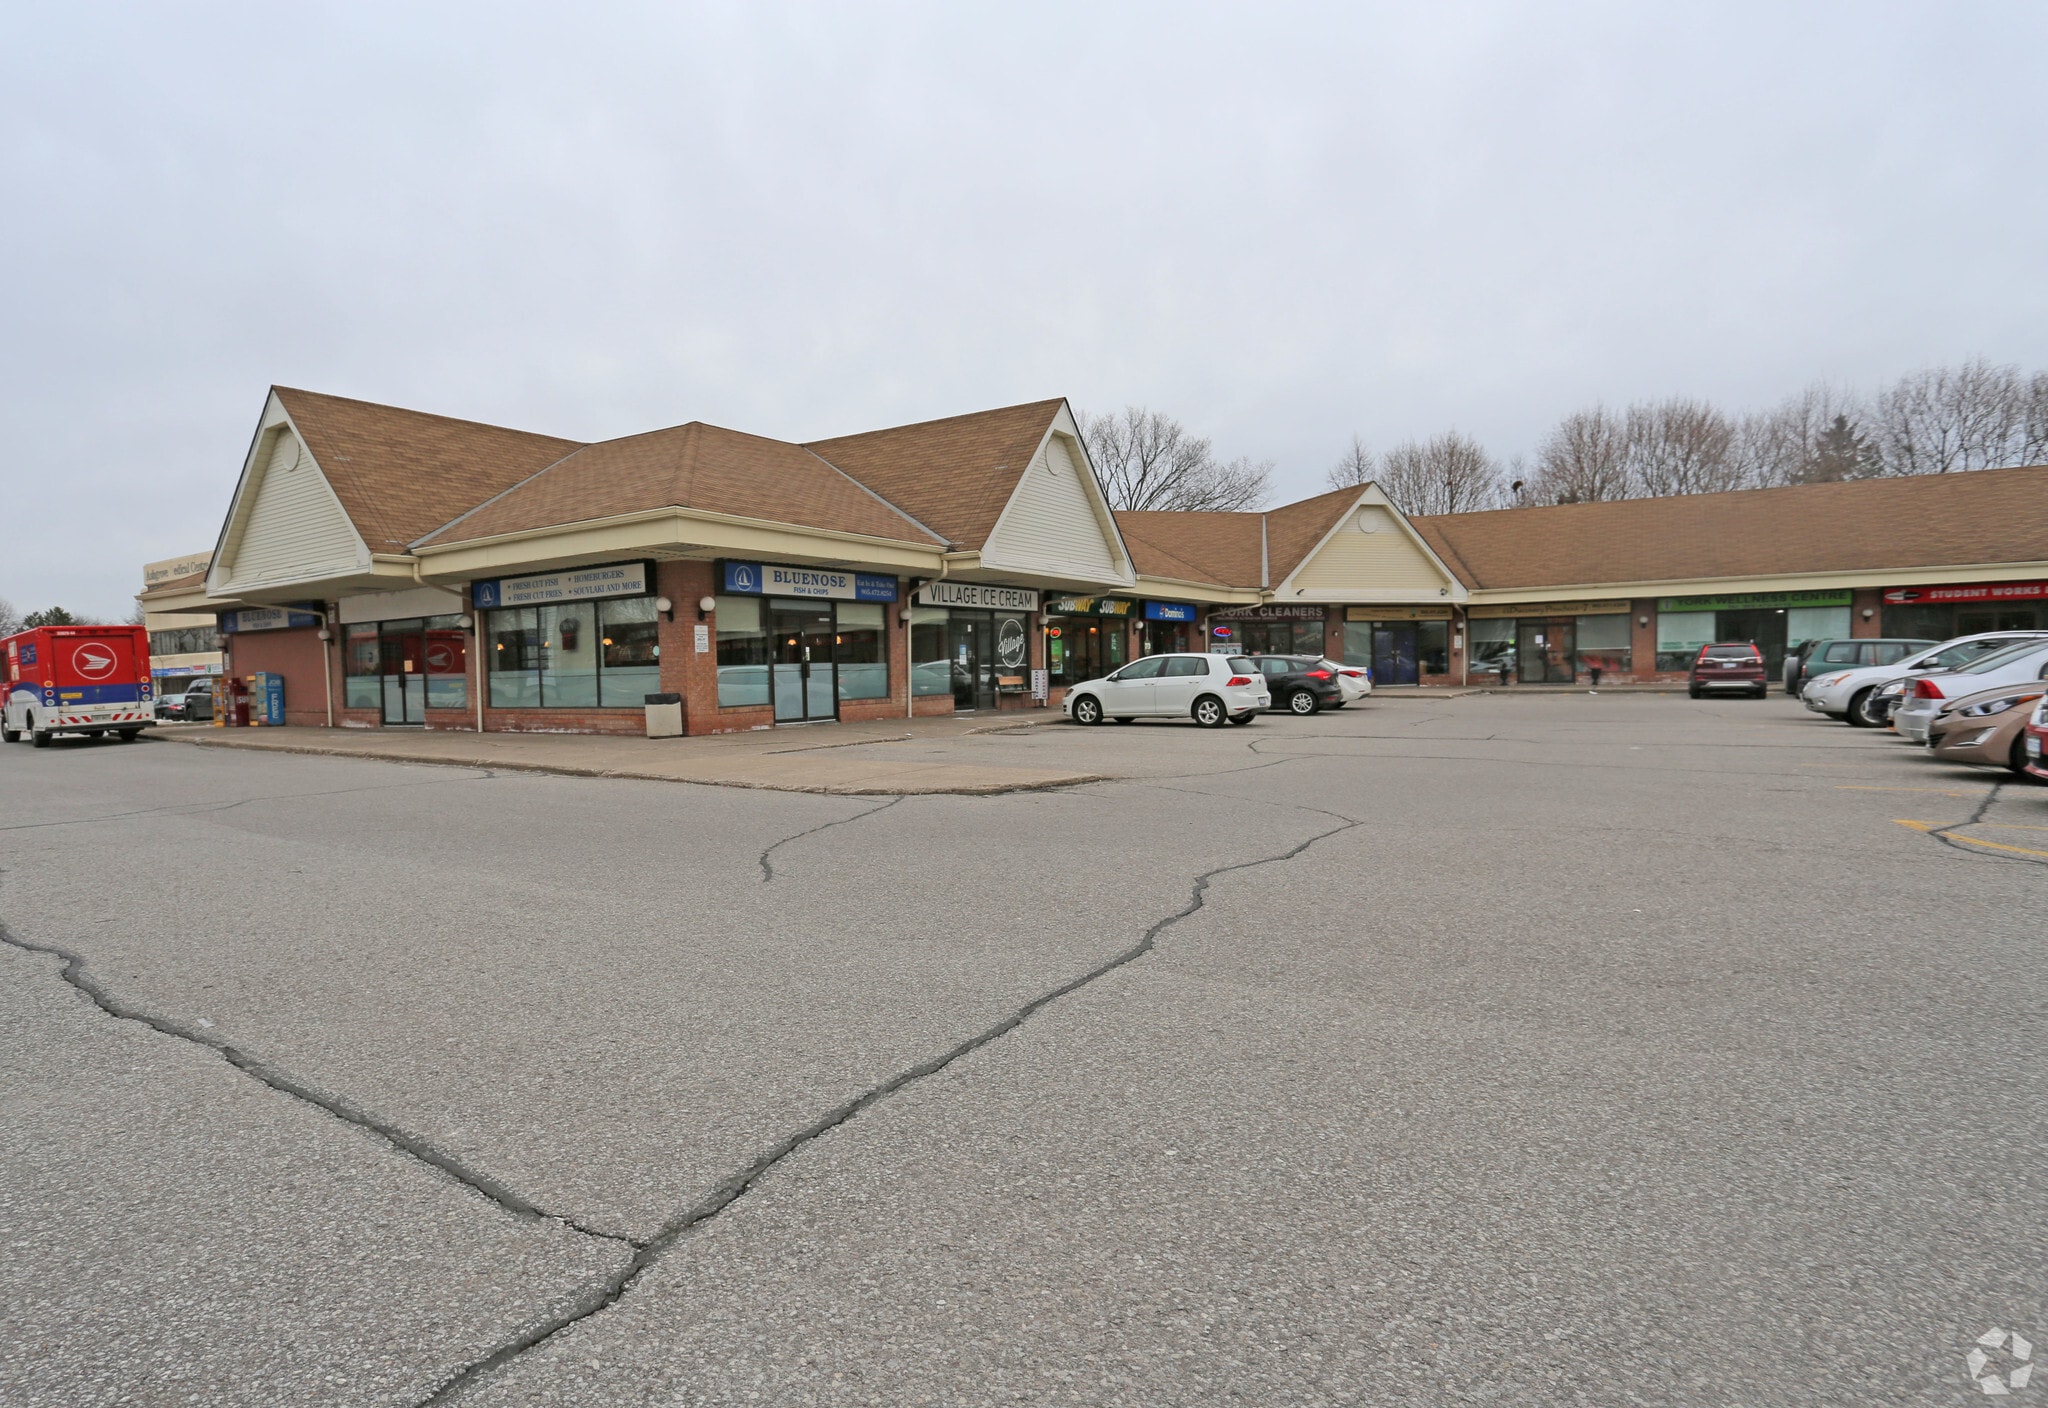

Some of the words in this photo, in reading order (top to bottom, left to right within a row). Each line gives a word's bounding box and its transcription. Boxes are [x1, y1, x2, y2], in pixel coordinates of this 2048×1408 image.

[574, 570, 625, 583] HOMEBURGERS
[773, 570, 847, 588] BLUENOSE
[513, 581, 531, 591] FRESH
[532, 580, 544, 588] CUT
[545, 578, 559, 587] FISH
[574, 584, 605, 595] SOUVLAKI
[606, 582, 620, 592] AND
[622, 580, 642, 590] MORE
[793, 586, 807, 594] FISH
[813, 588, 830, 596] CHIPS
[514, 592, 532, 601] FRESH
[533, 591, 545, 600] CUT
[546, 589, 563, 598] FRIES
[930, 584, 977, 604] VILLAGE
[980, 587, 996, 606] ICE
[999, 590, 1032, 608] CREAM
[1678, 598, 1712, 607] YORK
[1716, 593, 1788, 605] WELLNESS
[1791, 590, 1848, 602] CENTRE
[1930, 588, 1988, 599] STUDENT
[1991, 586, 2041, 596] WORKS
[1058, 597, 1092, 613] SUBWAY
[1099, 600, 1128, 615] SUBWAY
[1219, 607, 1254, 617] YORK
[1259, 607, 1324, 617] CLEANERS
[1165, 607, 1185, 619] Domino's
[998, 633, 1025, 657] Village
